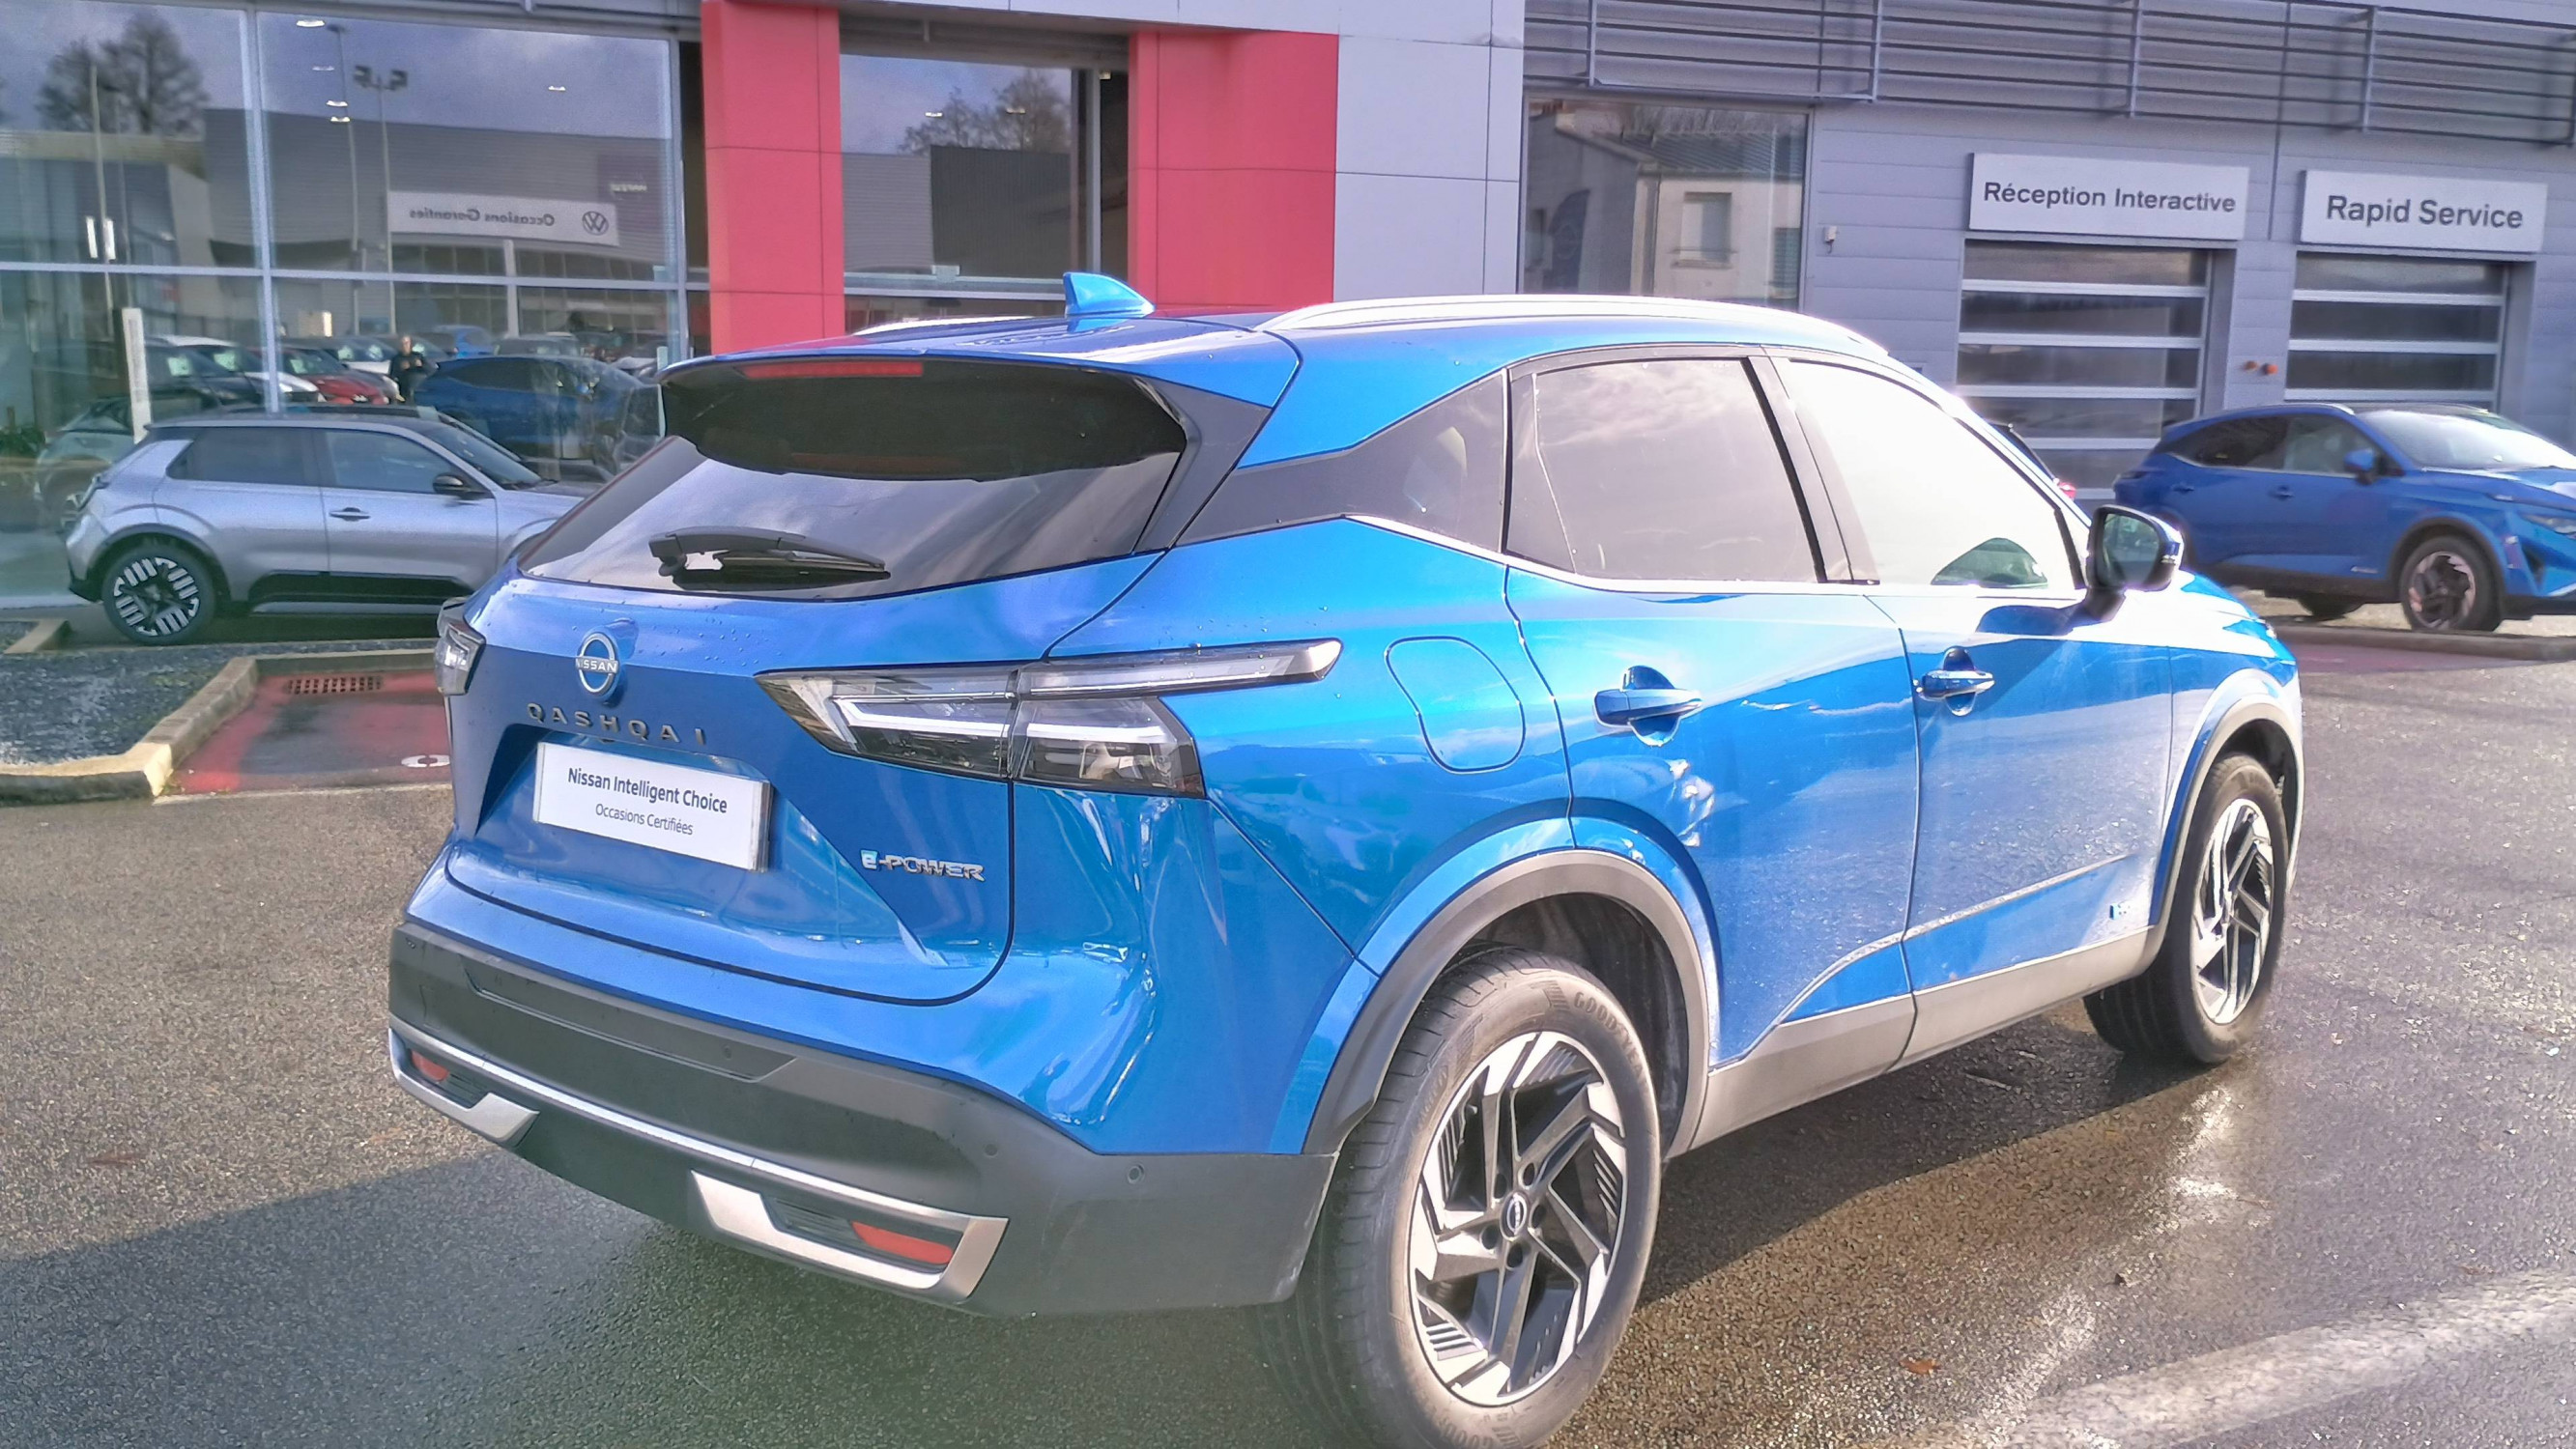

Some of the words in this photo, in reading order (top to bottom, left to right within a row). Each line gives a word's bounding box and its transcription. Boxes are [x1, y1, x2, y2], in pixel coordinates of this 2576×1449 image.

[1984, 182, 2106, 209] Réception
[2114, 187, 2236, 213] Interactive
[2326, 195, 2411, 224] Rapid
[2419, 200, 2524, 229] Service
[527, 702, 706, 746] QASHQAI
[568, 767, 611, 791] Nissan
[614, 776, 680, 805] Intelligent
[682, 789, 728, 813] Choice
[595, 803, 645, 825] Occasions
[646, 813, 694, 836] Certifiées
